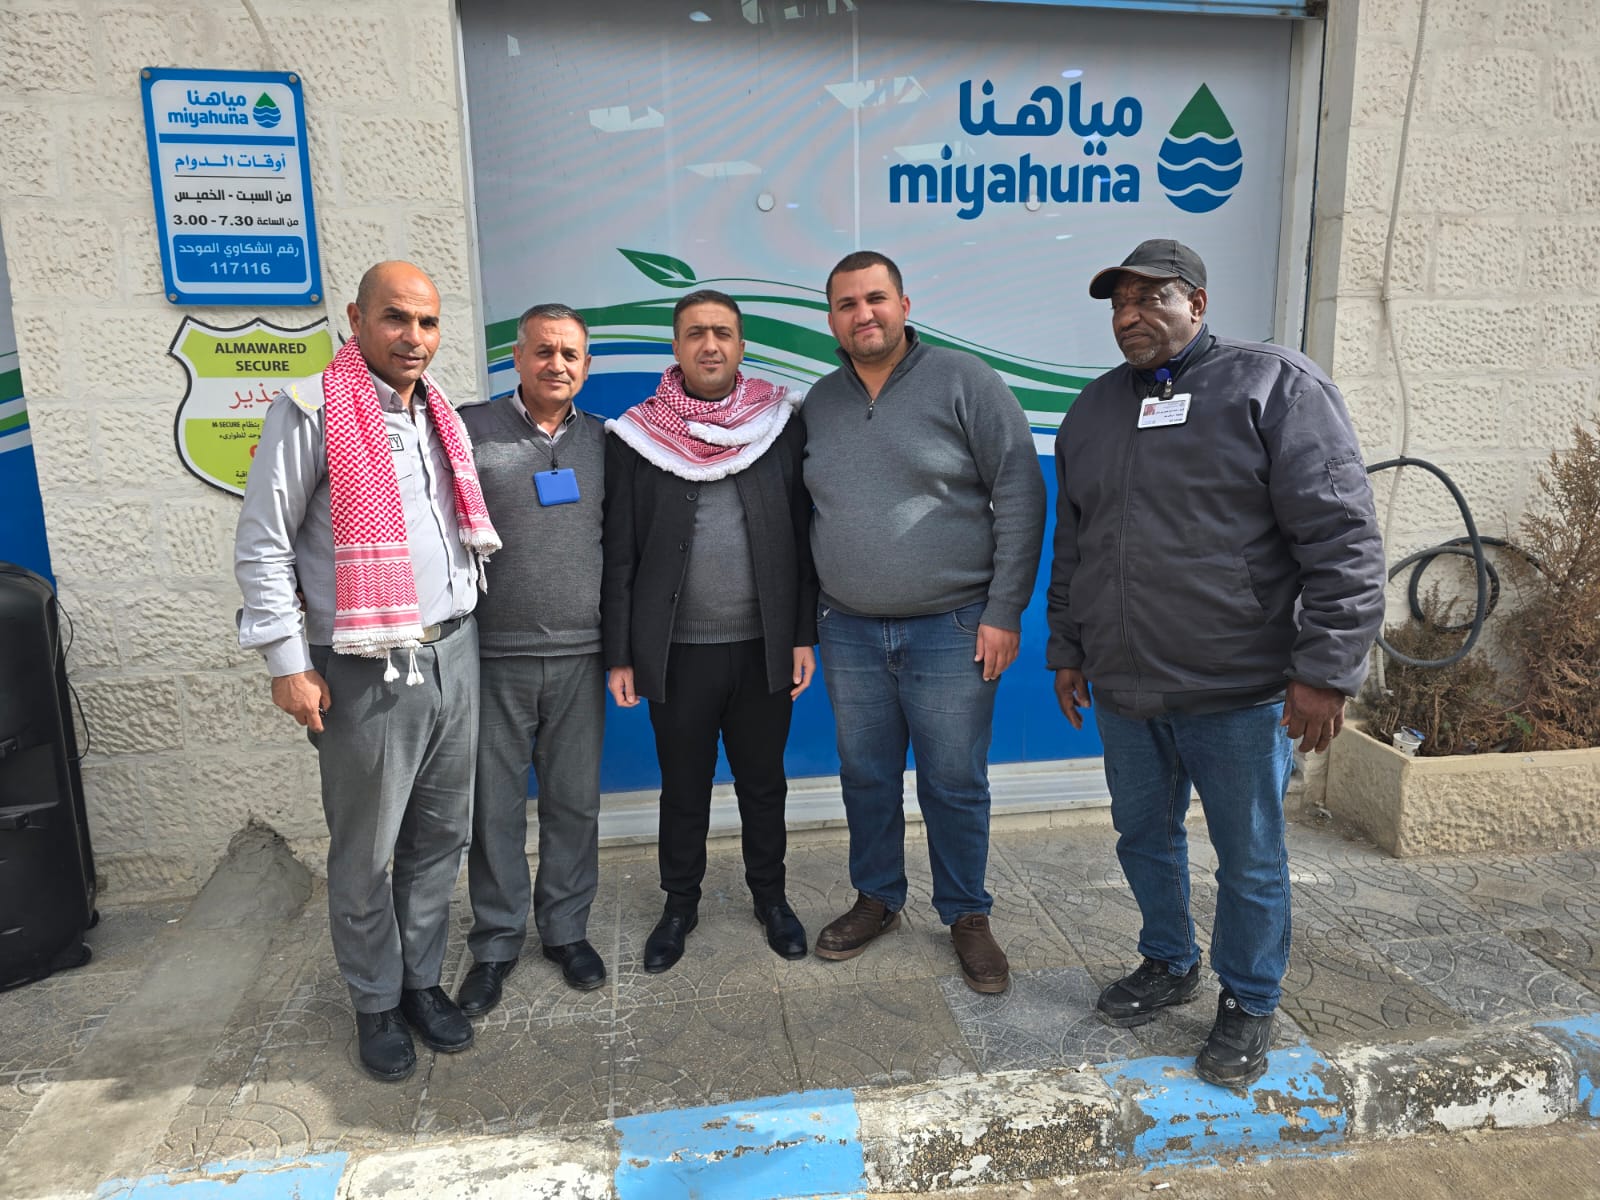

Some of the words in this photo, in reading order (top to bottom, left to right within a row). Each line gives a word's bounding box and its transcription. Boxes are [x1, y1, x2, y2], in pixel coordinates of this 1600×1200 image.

[187, 90, 247, 111] مياهنا
[168, 108, 249, 128] miyahuna
[959, 79, 1143, 156] مياهنا
[175, 154, 234, 171] الدوام
[237, 153, 286, 172] أوقات
[889, 144, 1141, 220] miyahuna
[174, 189, 225, 203] الخميس
[236, 190, 272, 204] السبت
[276, 191, 292, 204] من
[257, 217, 285, 226] الساعة
[287, 218, 299, 227] من
[179, 242, 220, 257] الموحد
[276, 244, 299, 257] رقم
[210, 262, 271, 275] 117116
[215, 343, 307, 354] ALMAWARED
[236, 360, 290, 371] SECURE
[388, 436, 400, 448] TY
